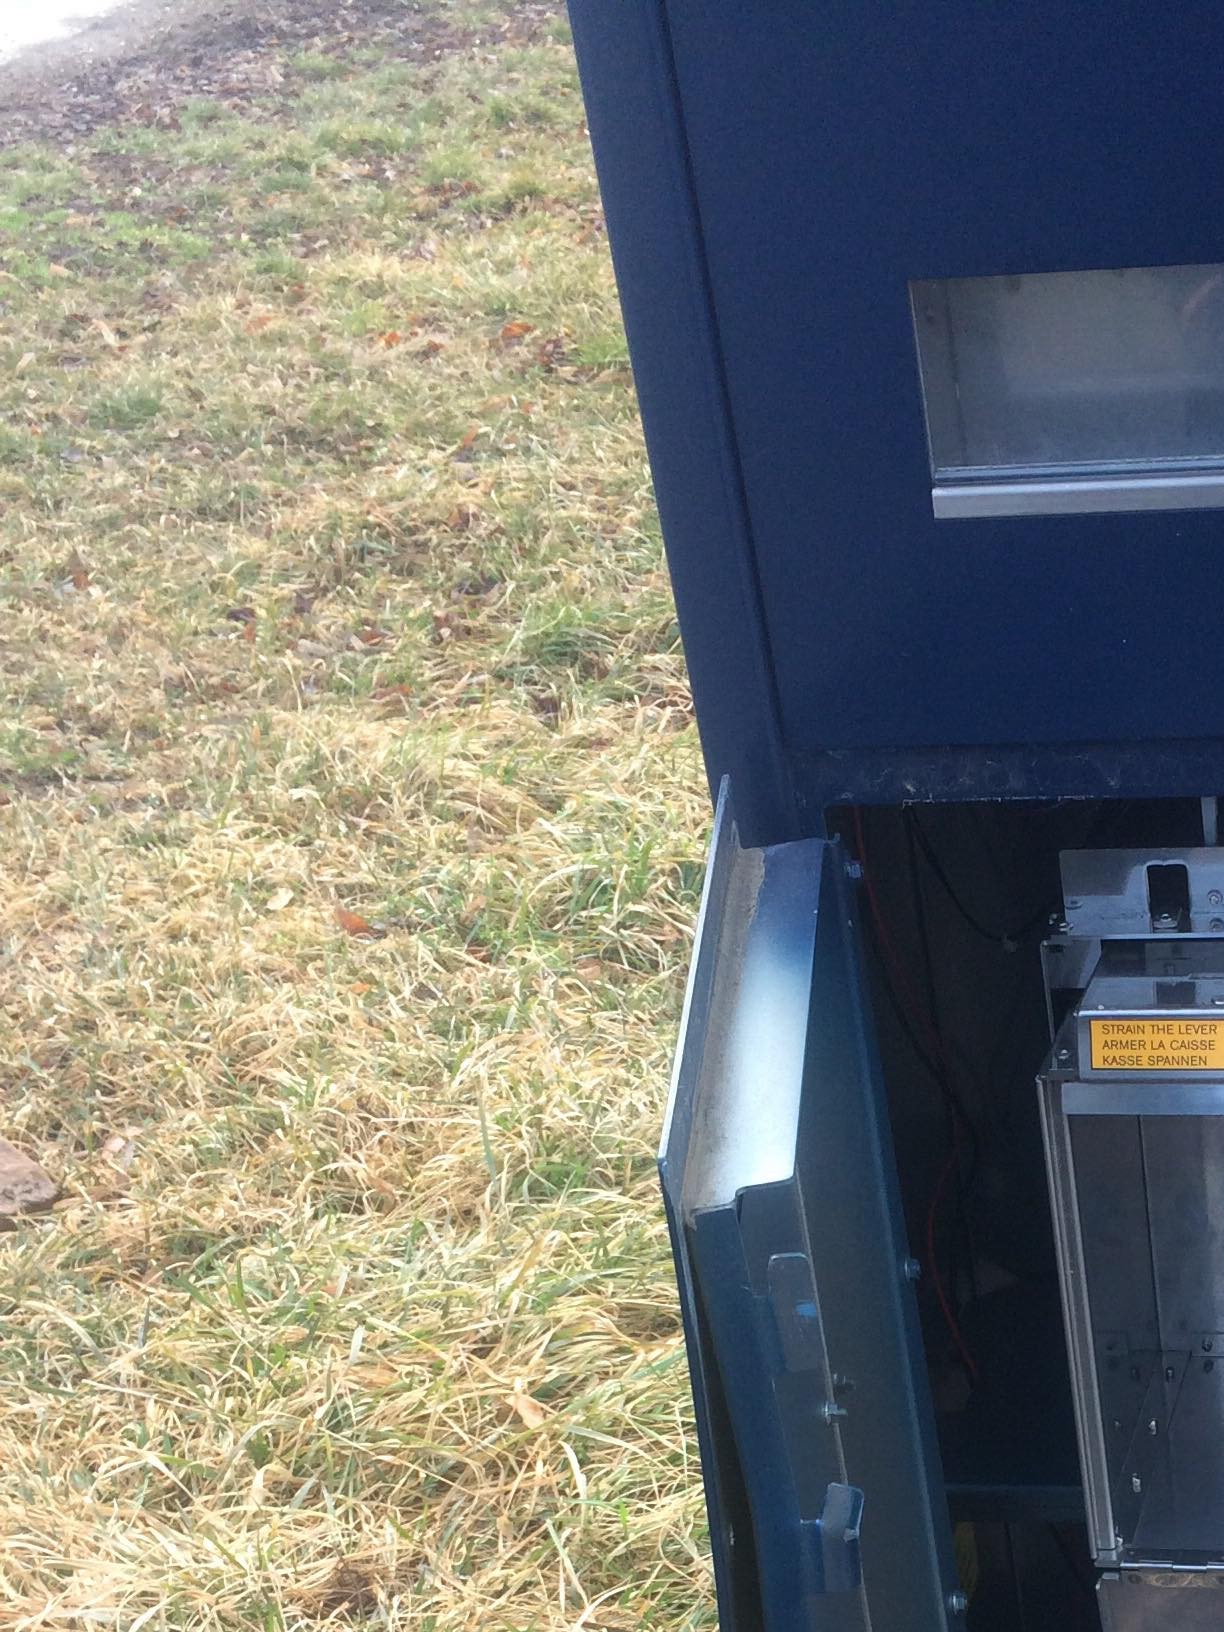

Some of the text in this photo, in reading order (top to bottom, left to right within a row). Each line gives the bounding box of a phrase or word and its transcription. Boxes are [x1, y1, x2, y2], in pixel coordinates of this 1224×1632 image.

[1101, 1023, 1218, 1035] STRAIN THE LEVER
[1102, 1039, 1216, 1051] ARMER LA CAISSE
[1102, 1055, 1208, 1066] KASSE SPANNEN
